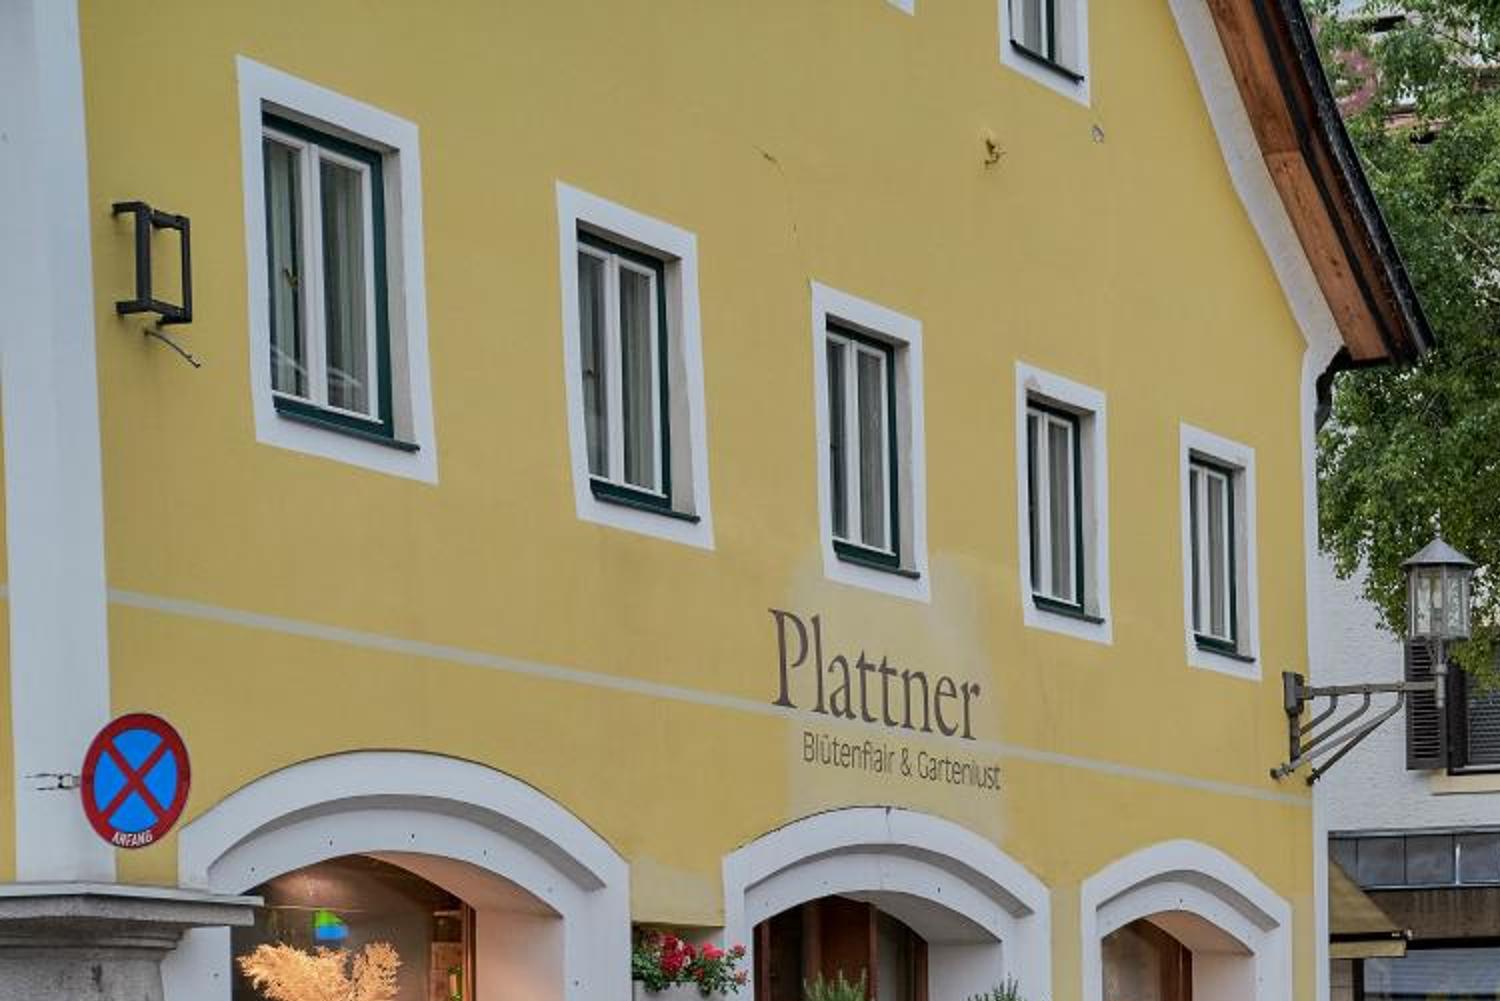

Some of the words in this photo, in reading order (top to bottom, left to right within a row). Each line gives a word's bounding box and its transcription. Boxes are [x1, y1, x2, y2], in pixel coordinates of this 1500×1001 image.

[768, 607, 981, 741] Plattner
[901, 747, 912, 777] &
[917, 751, 1001, 790] Gartenlust
[111, 830, 153, 847] ANFANG
